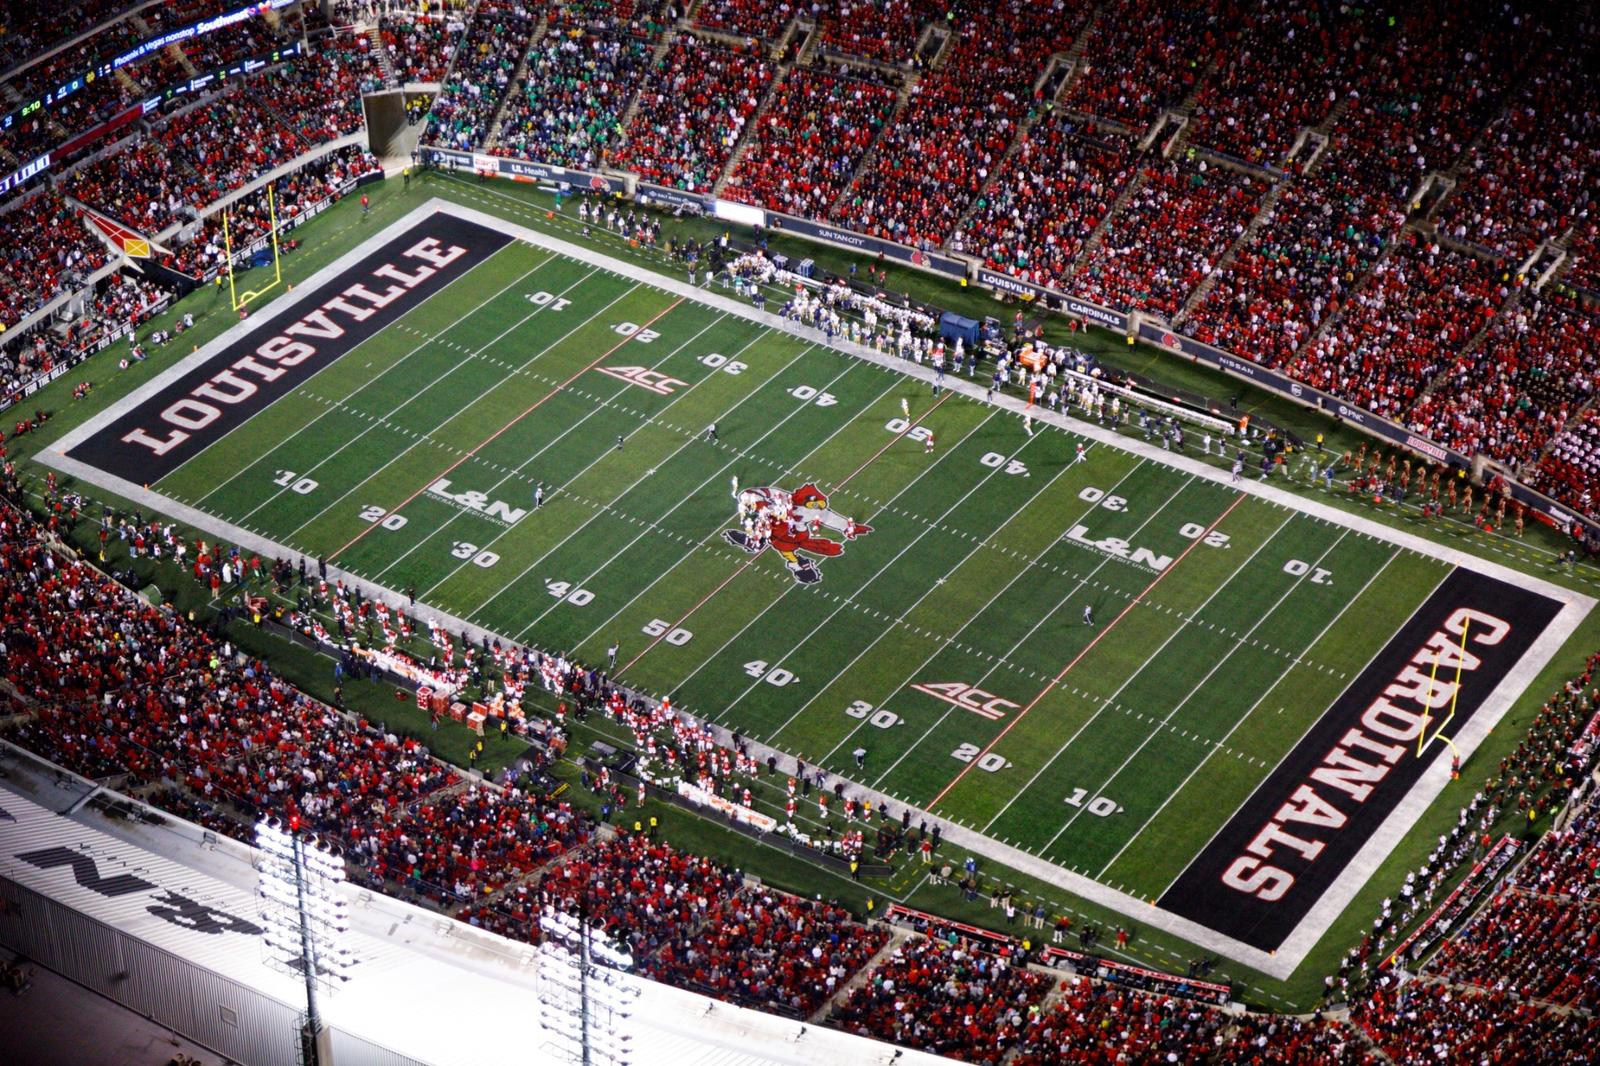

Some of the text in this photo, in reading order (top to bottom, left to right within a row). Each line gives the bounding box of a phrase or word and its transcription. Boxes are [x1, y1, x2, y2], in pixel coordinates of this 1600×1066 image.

[196, 6, 250, 35] Southwest
[145, 37, 165, 51] Vegas
[165, 27, 195, 43] nonstop
[14, 154, 50, 185] LOUD
[524, 167, 549, 178] Health
[819, 229, 865, 246] SUN TAN CITY
[982, 273, 1036, 295] LOUISVILLE
[530, 291, 573, 311] 10
[1070, 302, 1120, 325] CARDINALS
[614, 321, 662, 344] 20
[121, 237, 468, 456] LOUISVILLE
[702, 352, 749, 376] 30
[1218, 356, 1254, 375] NISSAN
[25, 362, 70, 397] FOR THE VILLE
[595, 366, 690, 395] ACC
[792, 386, 839, 407] 40
[885, 417, 934, 442] 50
[1347, 410, 1364, 423] PNC
[979, 451, 1027, 475] 40
[273, 470, 319, 495] 10
[422, 490, 455, 508] FEDERAL
[484, 514, 512, 529] UNION
[428, 478, 527, 524] L&N
[1078, 486, 1127, 511] 30
[358, 505, 409, 531] 20
[1066, 524, 1174, 572] L&N
[1179, 522, 1230, 548] 20
[451, 542, 500, 568] 30
[1062, 536, 1099, 555] FEDERAL
[1130, 562, 1161, 576] UNION
[1284, 559, 1331, 584] 10
[547, 580, 596, 607] 40
[642, 618, 693, 646] 50
[743, 660, 794, 687] 40
[911, 682, 1021, 720] ACC
[845, 700, 898, 729] 30
[950, 742, 1006, 773] 20
[1222, 607, 1511, 902] CARDINALS
[1065, 787, 1117, 817] 10
